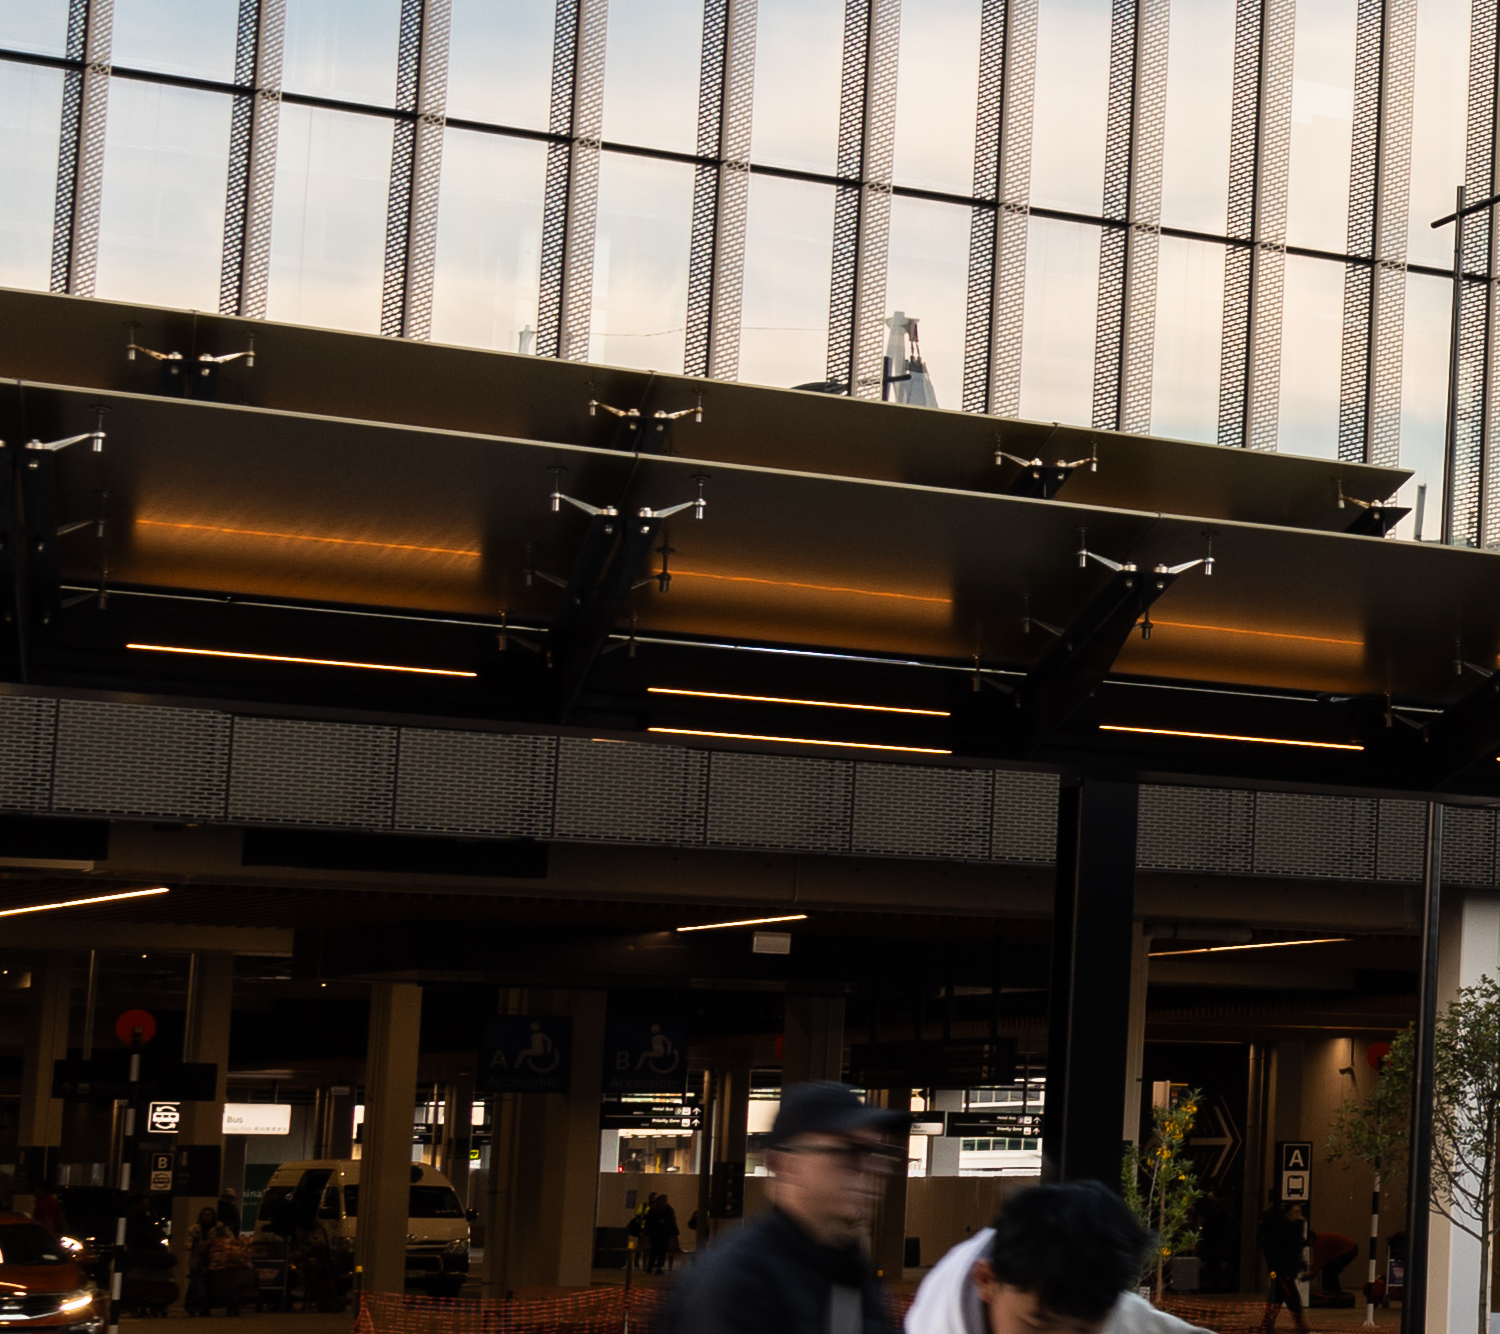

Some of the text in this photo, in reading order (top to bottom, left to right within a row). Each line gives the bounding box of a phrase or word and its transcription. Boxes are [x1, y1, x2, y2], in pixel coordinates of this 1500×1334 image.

[490, 1049, 508, 1068] A
[616, 1051, 630, 1070] B
[487, 1076, 560, 1088] Accessible
[610, 1076, 680, 1088] Accessible
[158, 1157, 167, 1168] B
[1288, 1149, 1304, 1167] A
